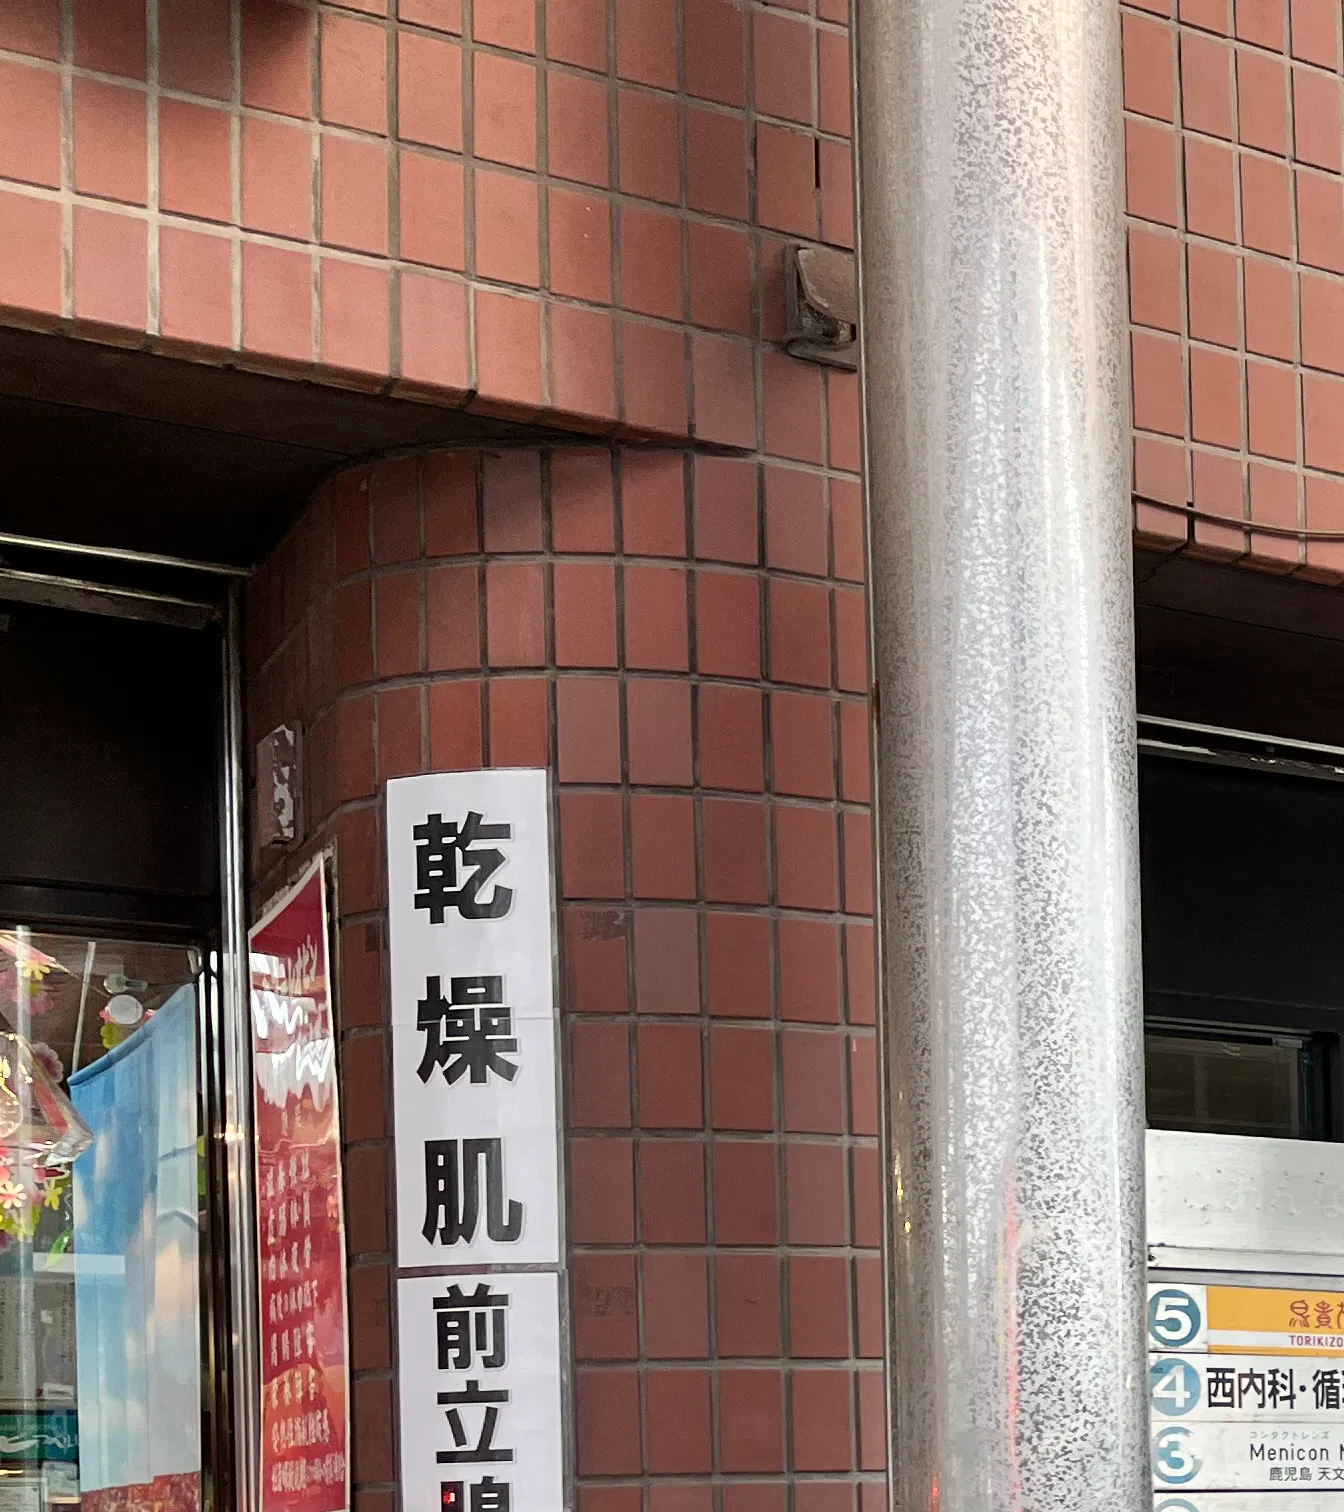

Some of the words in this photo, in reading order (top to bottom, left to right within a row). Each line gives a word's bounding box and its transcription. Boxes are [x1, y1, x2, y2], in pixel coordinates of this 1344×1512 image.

[413, 811, 522, 1246] 乾燥肌
[1155, 1298, 1192, 1341] 5
[1151, 1364, 1191, 1408] 4
[1249, 1443, 1329, 1461] Menicon
[1269, 1467, 1311, 1482] 鹿児島
